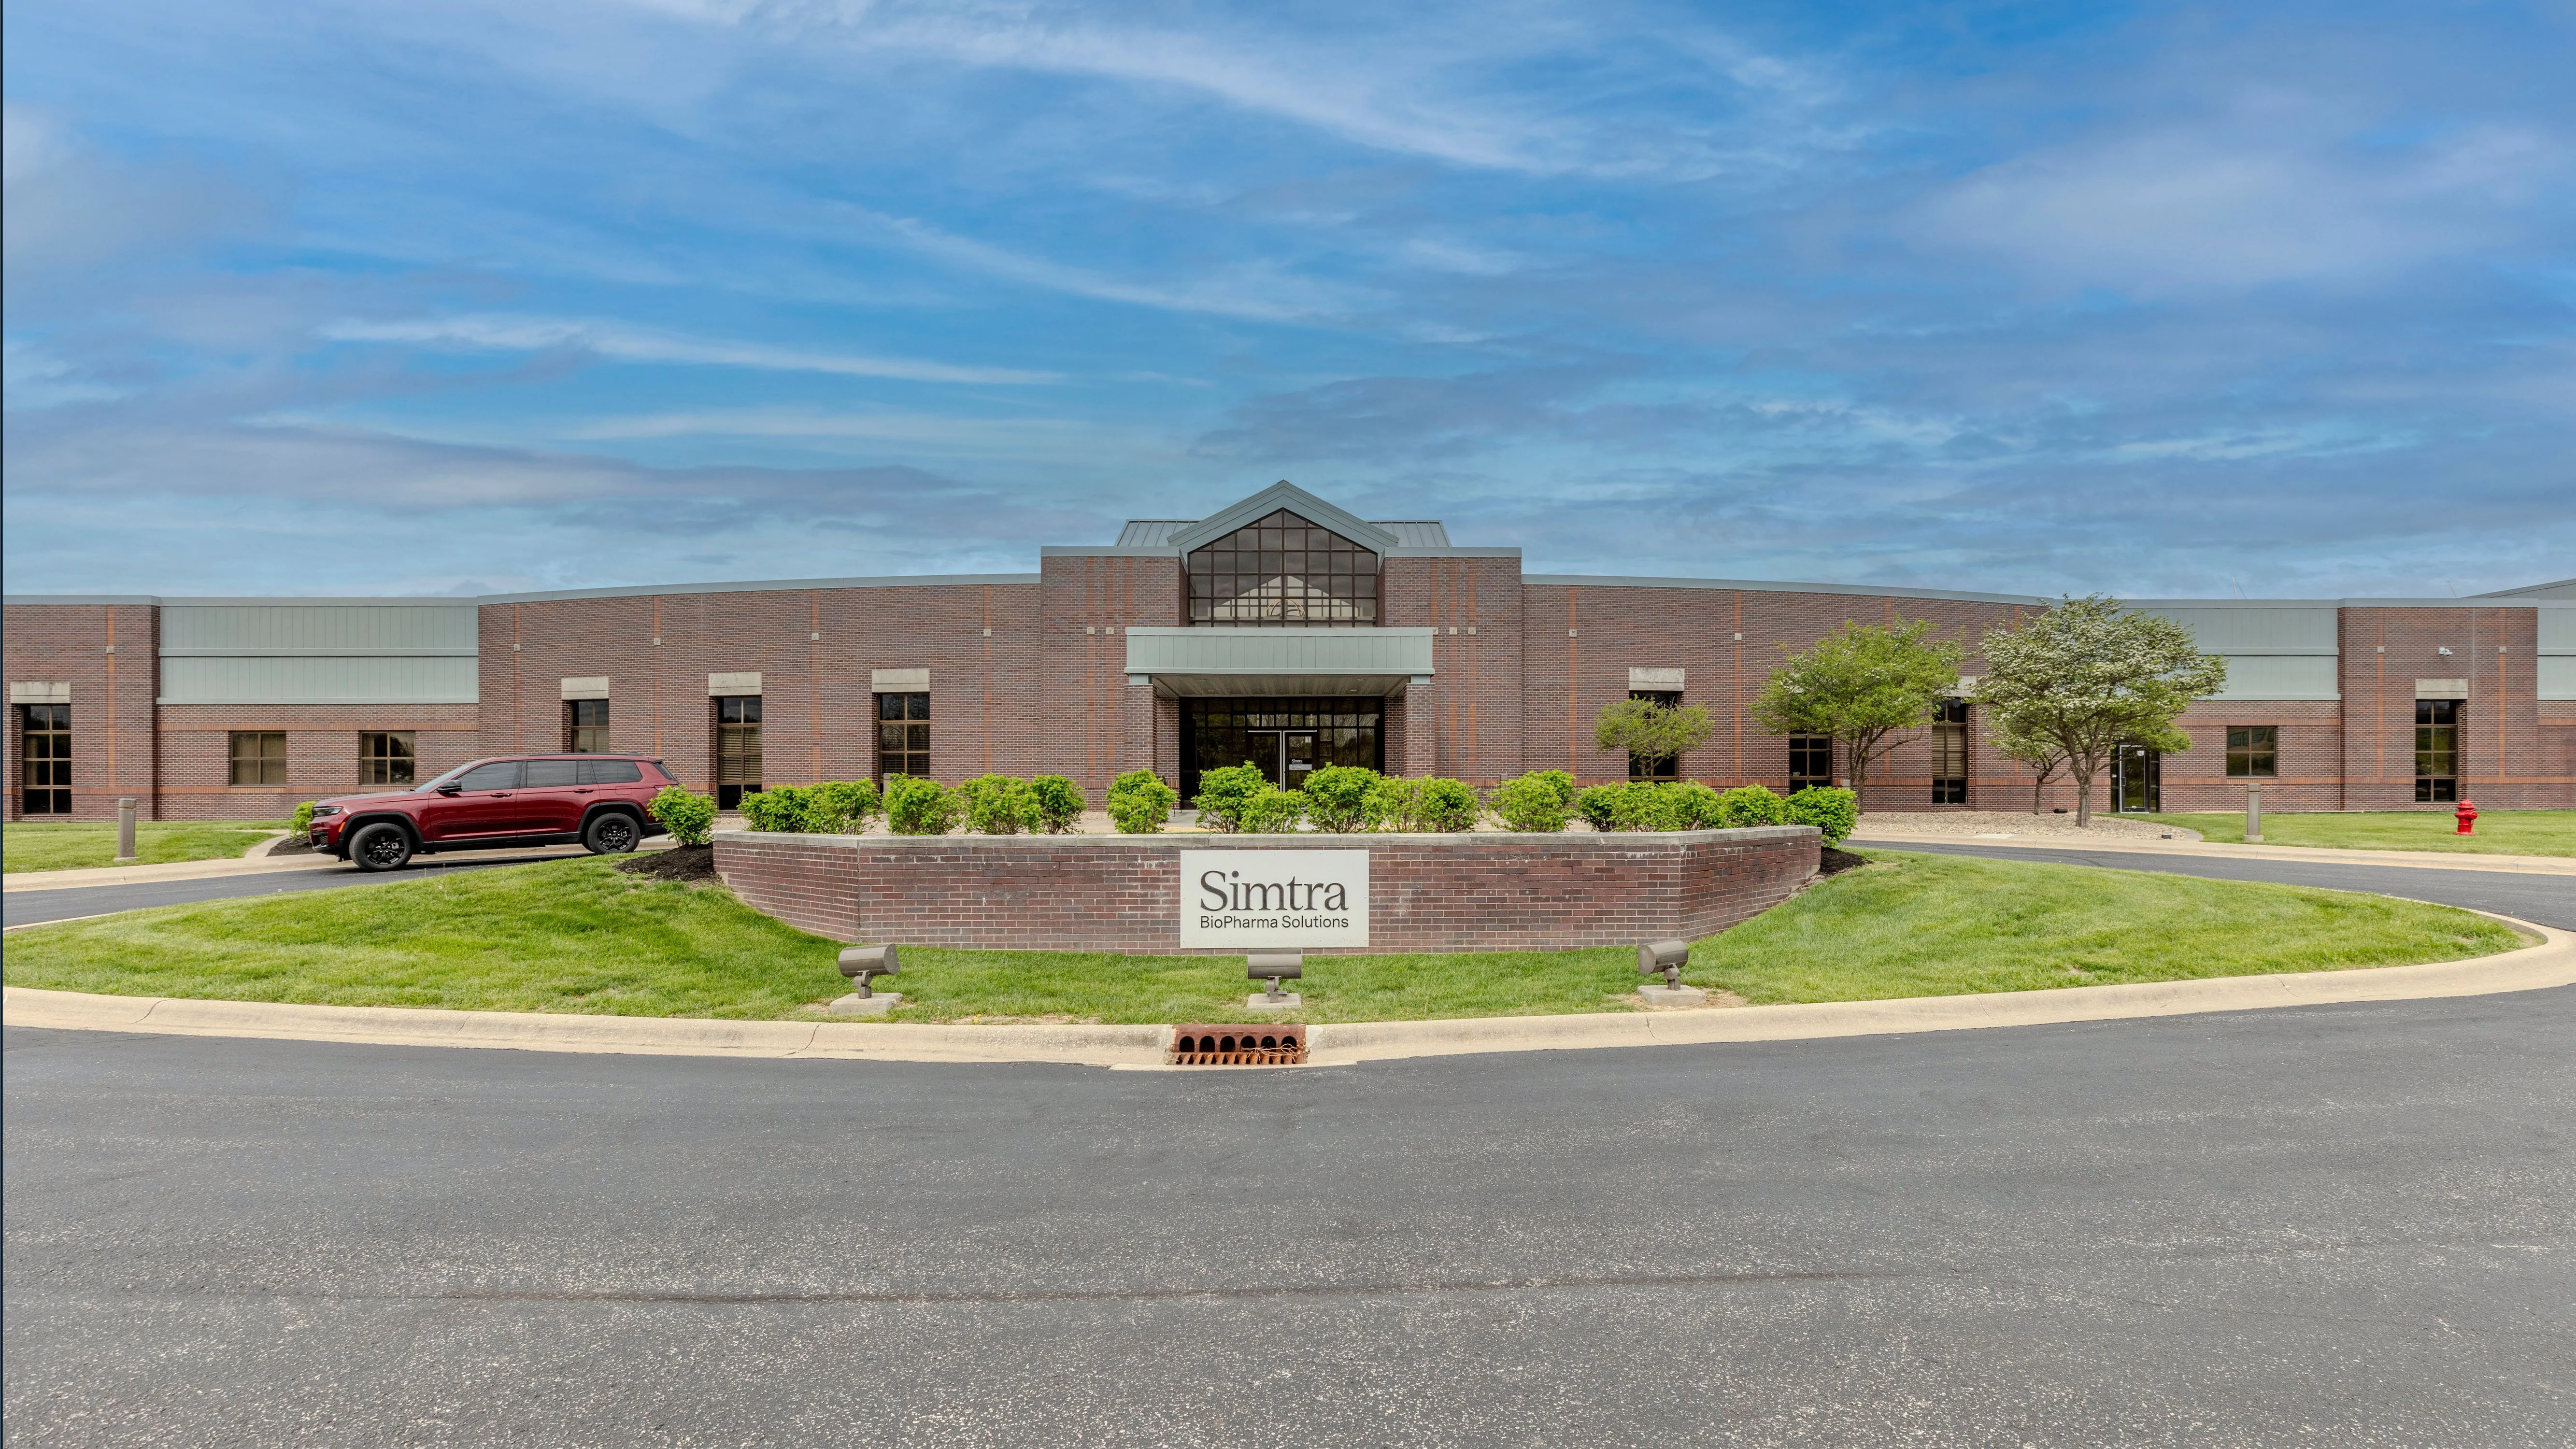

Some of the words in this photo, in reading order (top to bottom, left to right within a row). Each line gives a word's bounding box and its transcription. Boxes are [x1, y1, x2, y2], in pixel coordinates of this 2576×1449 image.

[1200, 870, 1349, 911] Simtra
[1201, 915, 1278, 928] BioPharma
[1281, 915, 1349, 928] Solutions
